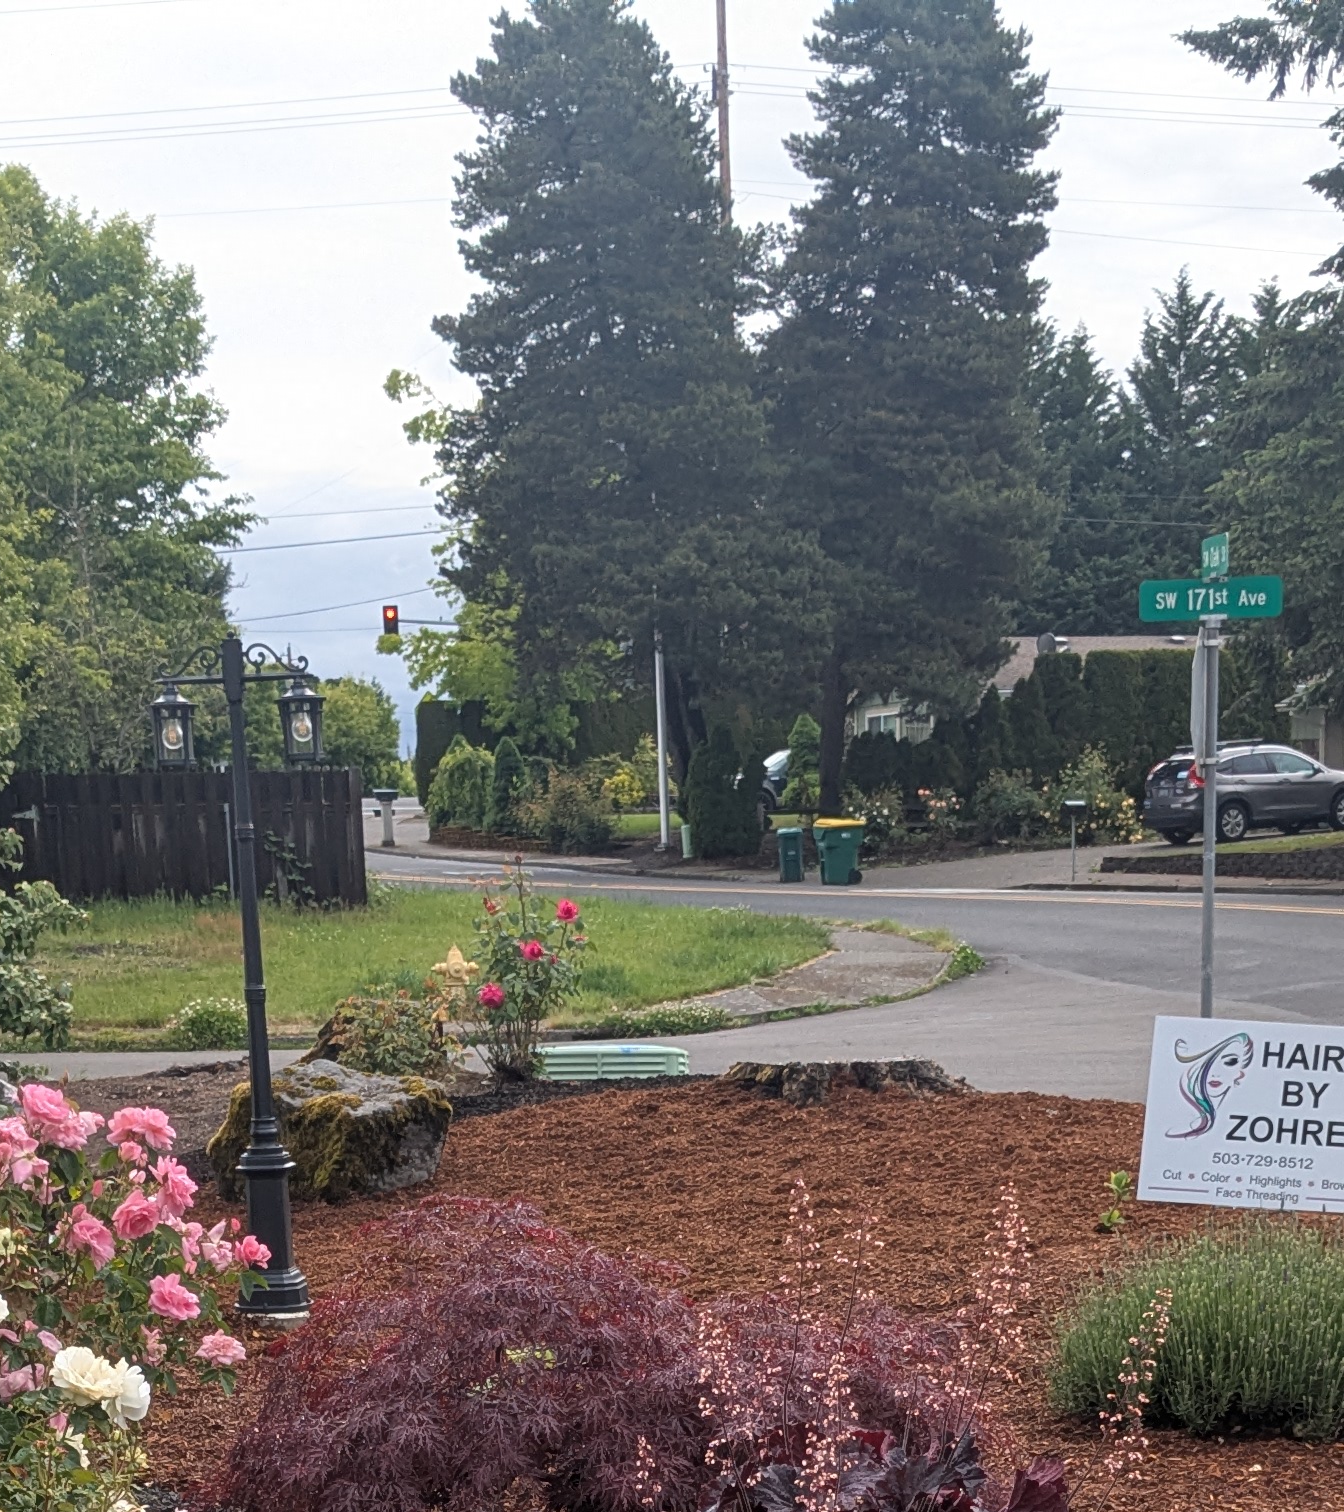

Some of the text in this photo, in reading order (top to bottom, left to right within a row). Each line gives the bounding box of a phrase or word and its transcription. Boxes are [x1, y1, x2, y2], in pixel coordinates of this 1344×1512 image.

[1155, 587, 1266, 611] SW 171st Ave
[1281, 1080, 1330, 1109] BY
[1162, 1169, 1182, 1181] Cut
[1201, 1171, 1231, 1184] Color
[1249, 1174, 1302, 1190] Highlights
[1215, 1187, 1299, 1204] Face Threading
